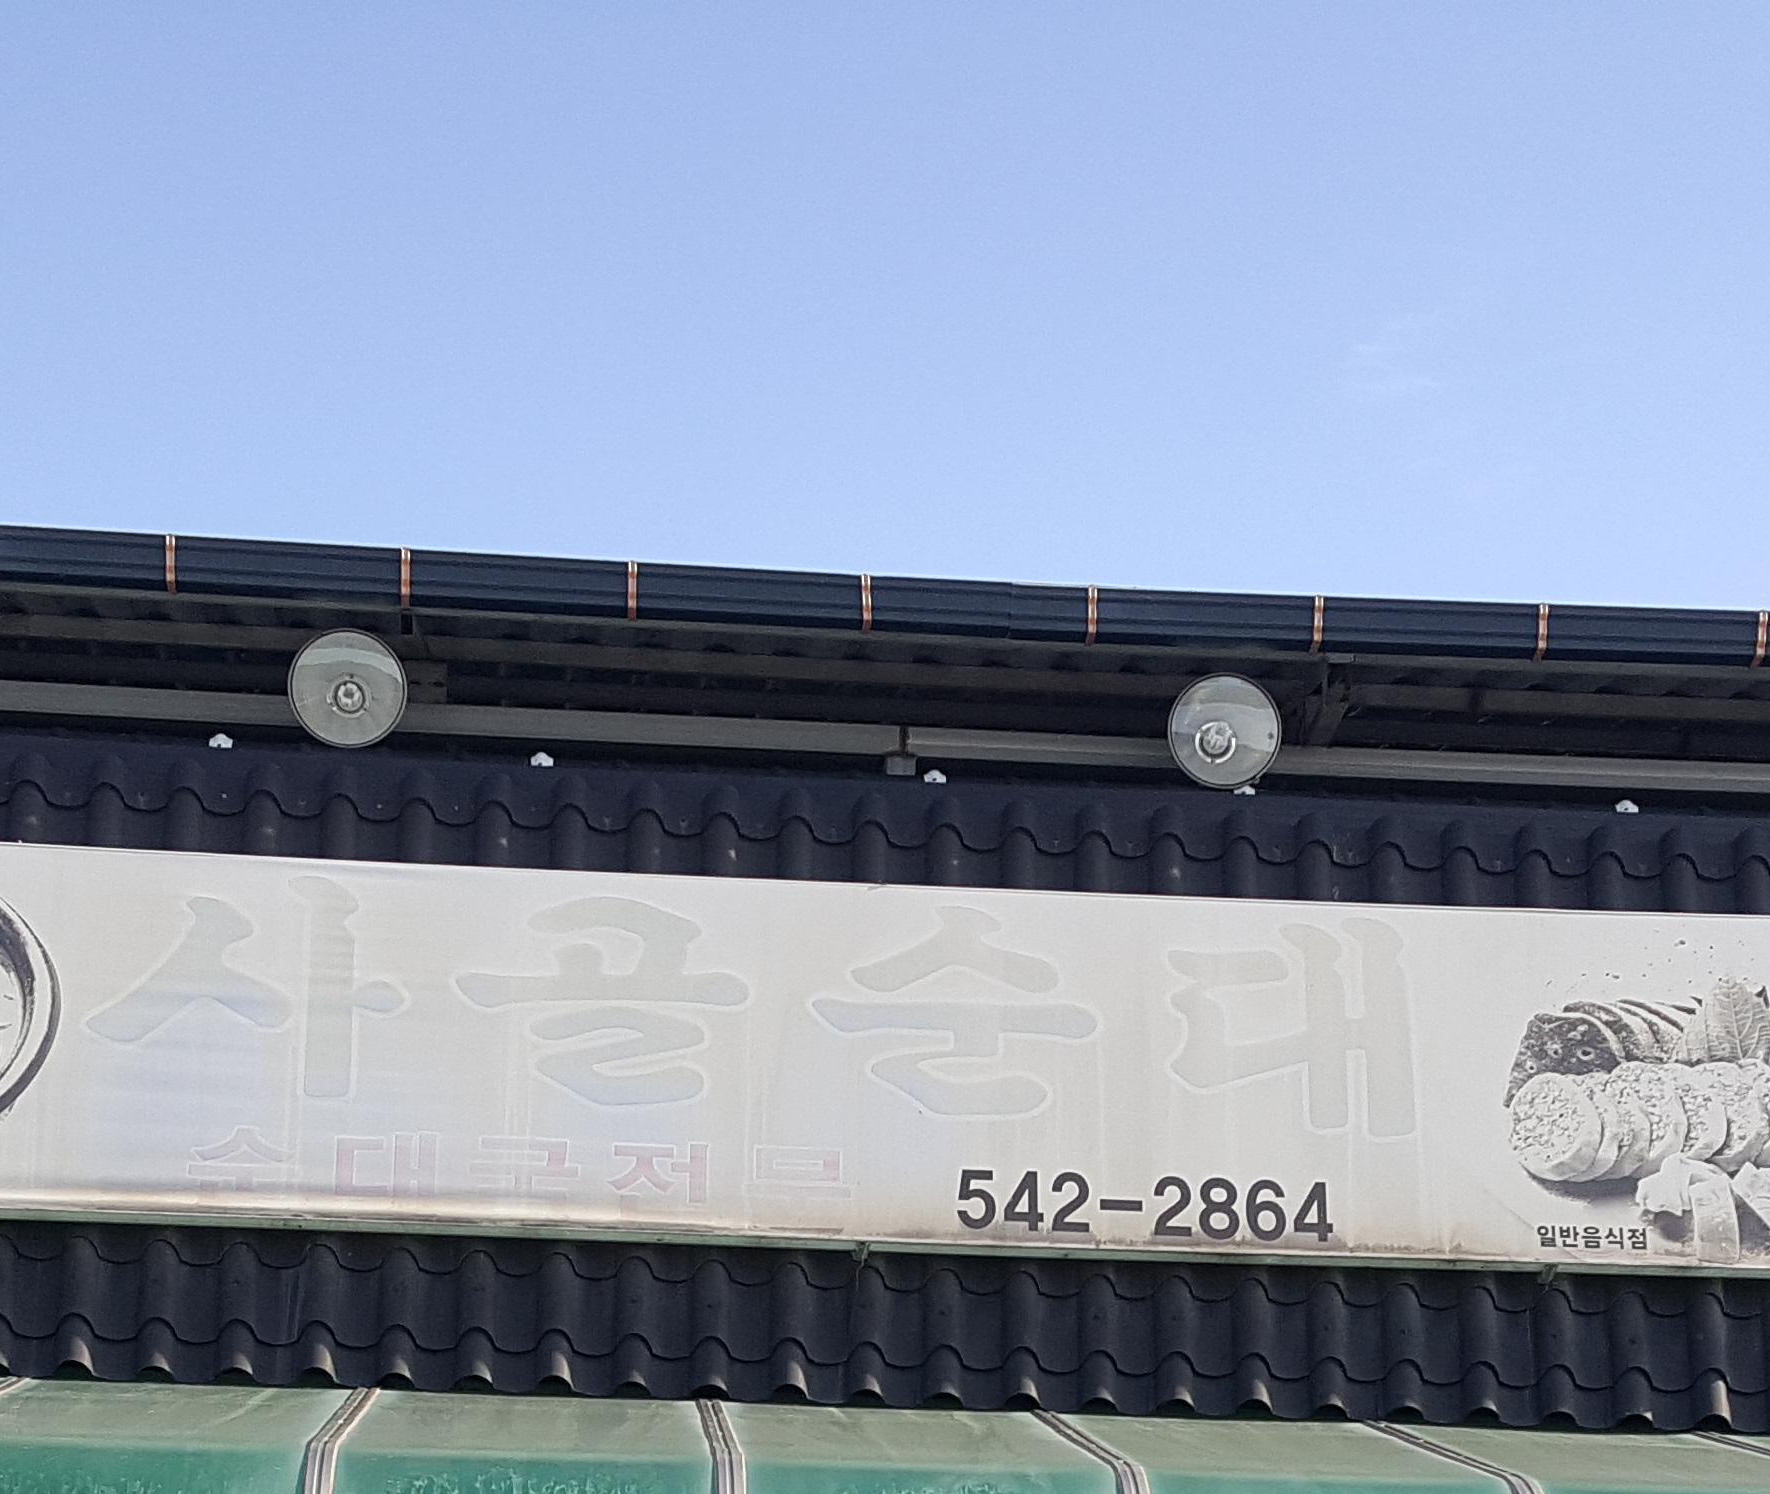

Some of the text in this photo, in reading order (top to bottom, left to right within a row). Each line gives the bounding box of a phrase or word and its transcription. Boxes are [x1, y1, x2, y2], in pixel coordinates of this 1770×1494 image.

[84, 873, 1418, 1140] 사골순대
[955, 1168, 1335, 1244] 542-2864
[1536, 1223, 1649, 1251] 일반음식점
